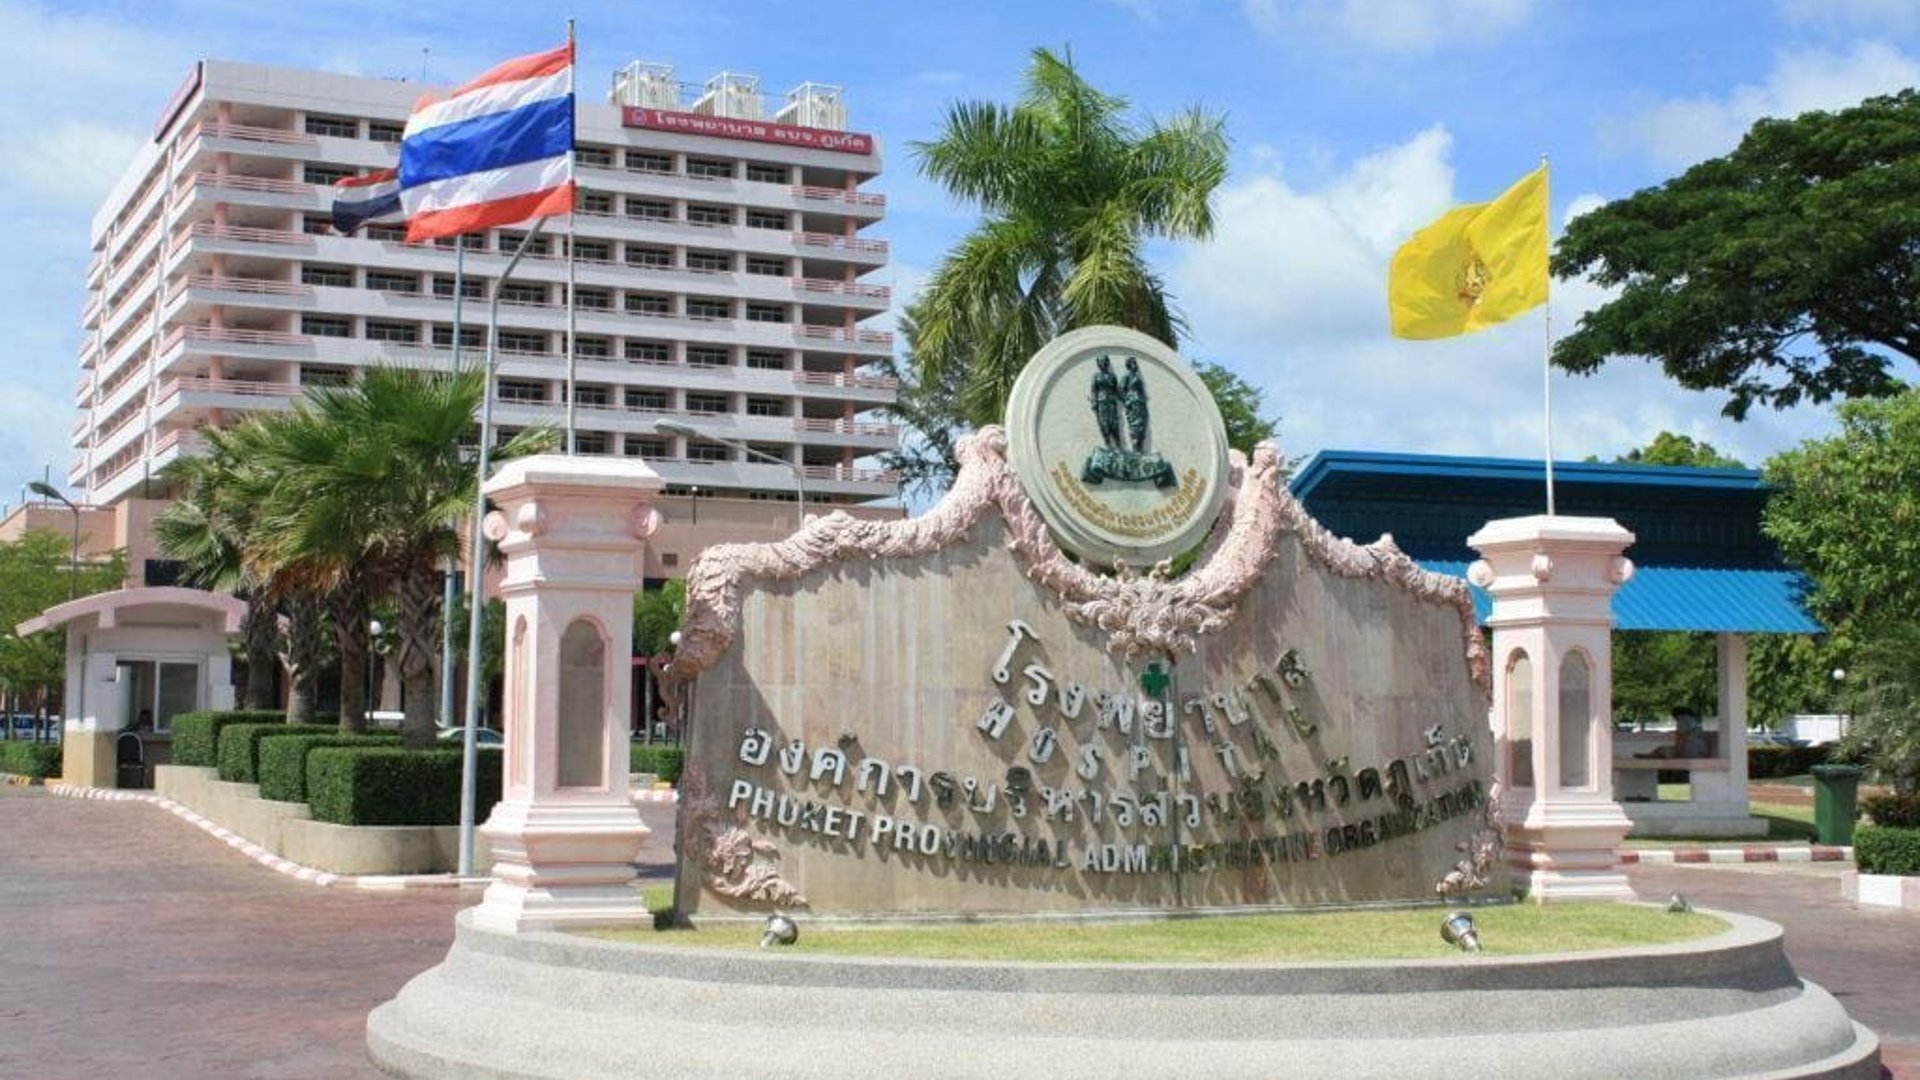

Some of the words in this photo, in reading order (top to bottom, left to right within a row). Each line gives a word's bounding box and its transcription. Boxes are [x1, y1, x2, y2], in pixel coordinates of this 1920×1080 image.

[992, 619, 1309, 738] โรงพยาบาล
[977, 697, 1316, 783] HOSPITAL
[729, 780, 867, 841] PHUKET
